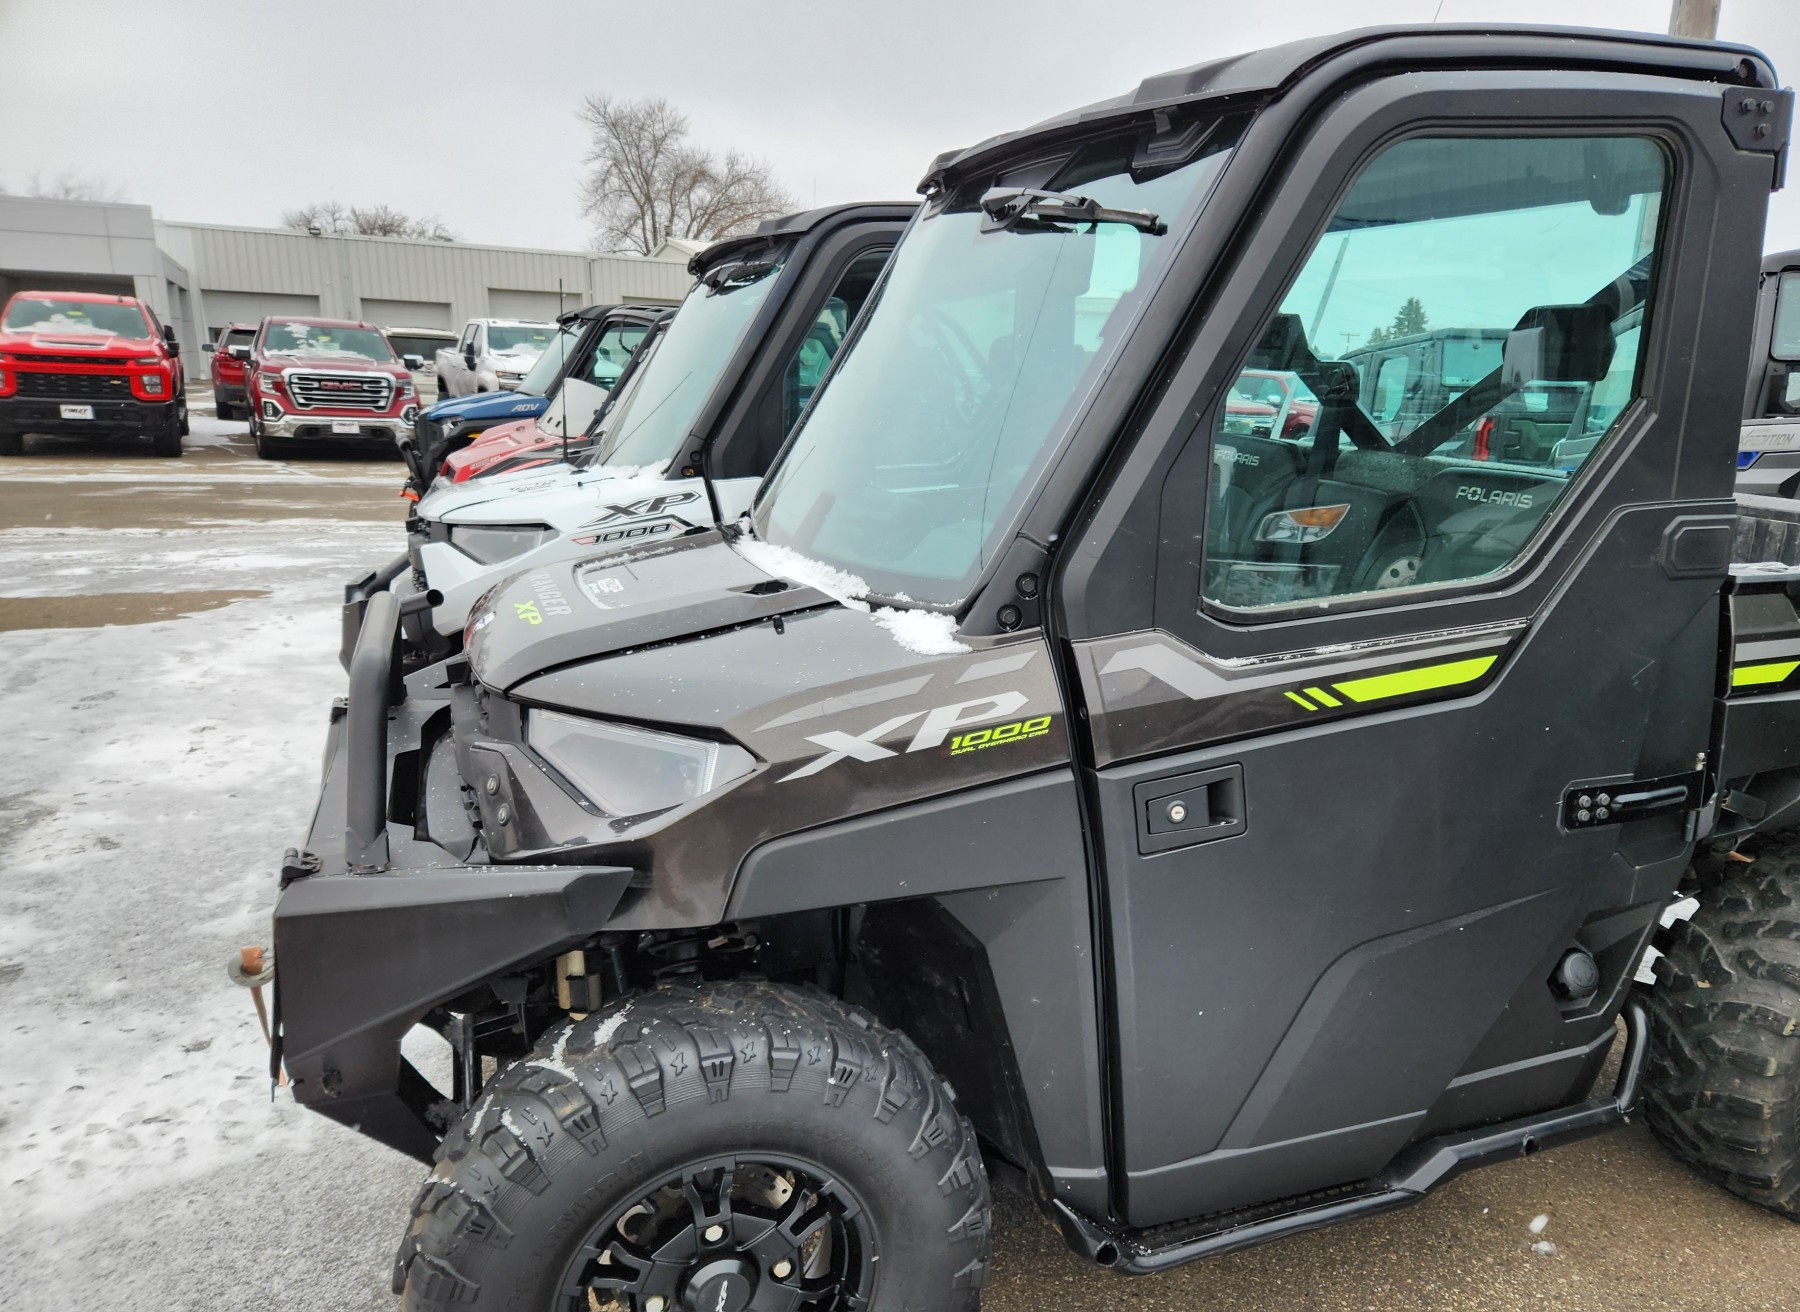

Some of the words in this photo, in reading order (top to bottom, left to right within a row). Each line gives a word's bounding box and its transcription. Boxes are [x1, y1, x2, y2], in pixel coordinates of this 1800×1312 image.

[511, 403, 540, 412] ADV
[1215, 449, 1260, 467] POLARIS
[578, 490, 701, 528] XP
[1455, 485, 1534, 509] POLARIS
[592, 522, 673, 545] 1000
[527, 573, 573, 616] RANGER
[513, 600, 543, 625] XP
[775, 690, 1029, 784] XP
[951, 716, 1052, 750] 1000
[951, 746, 976, 756] DUAL
[978, 733, 1028, 750] OVERHEAD
[1028, 729, 1049, 739] CAM
